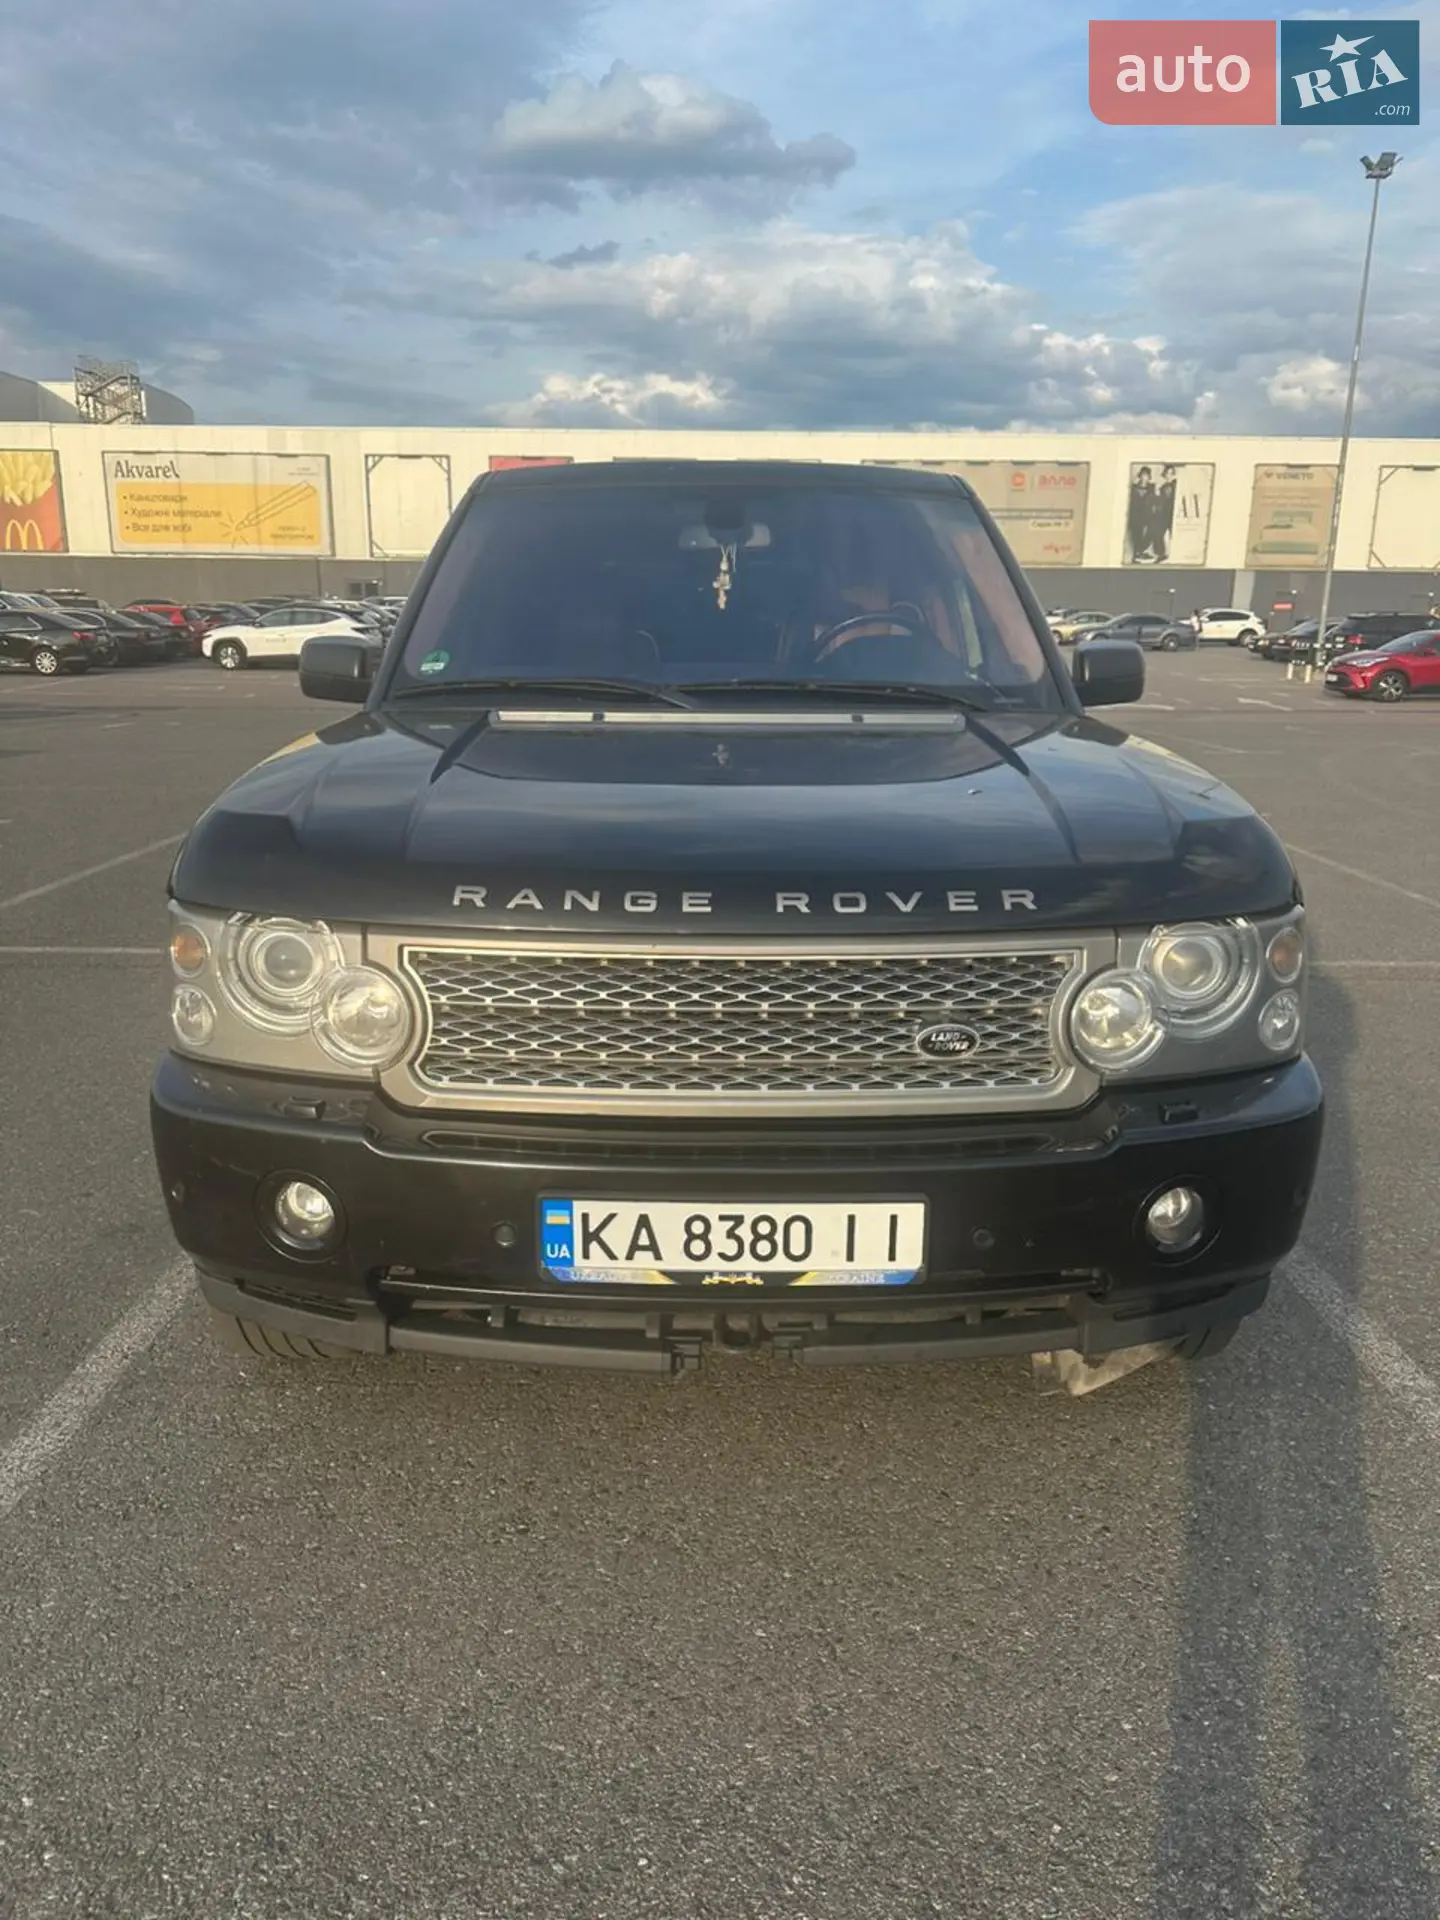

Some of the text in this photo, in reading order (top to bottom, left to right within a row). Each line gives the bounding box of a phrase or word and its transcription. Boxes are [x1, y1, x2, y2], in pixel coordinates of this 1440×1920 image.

[115, 460, 180, 480] Akvarel
[452, 885, 1037, 913] RANGE ROVER
[581, 1212, 663, 1261] KA
[683, 1214, 812, 1262] 8380
[547, 1244, 571, 1258] UA
